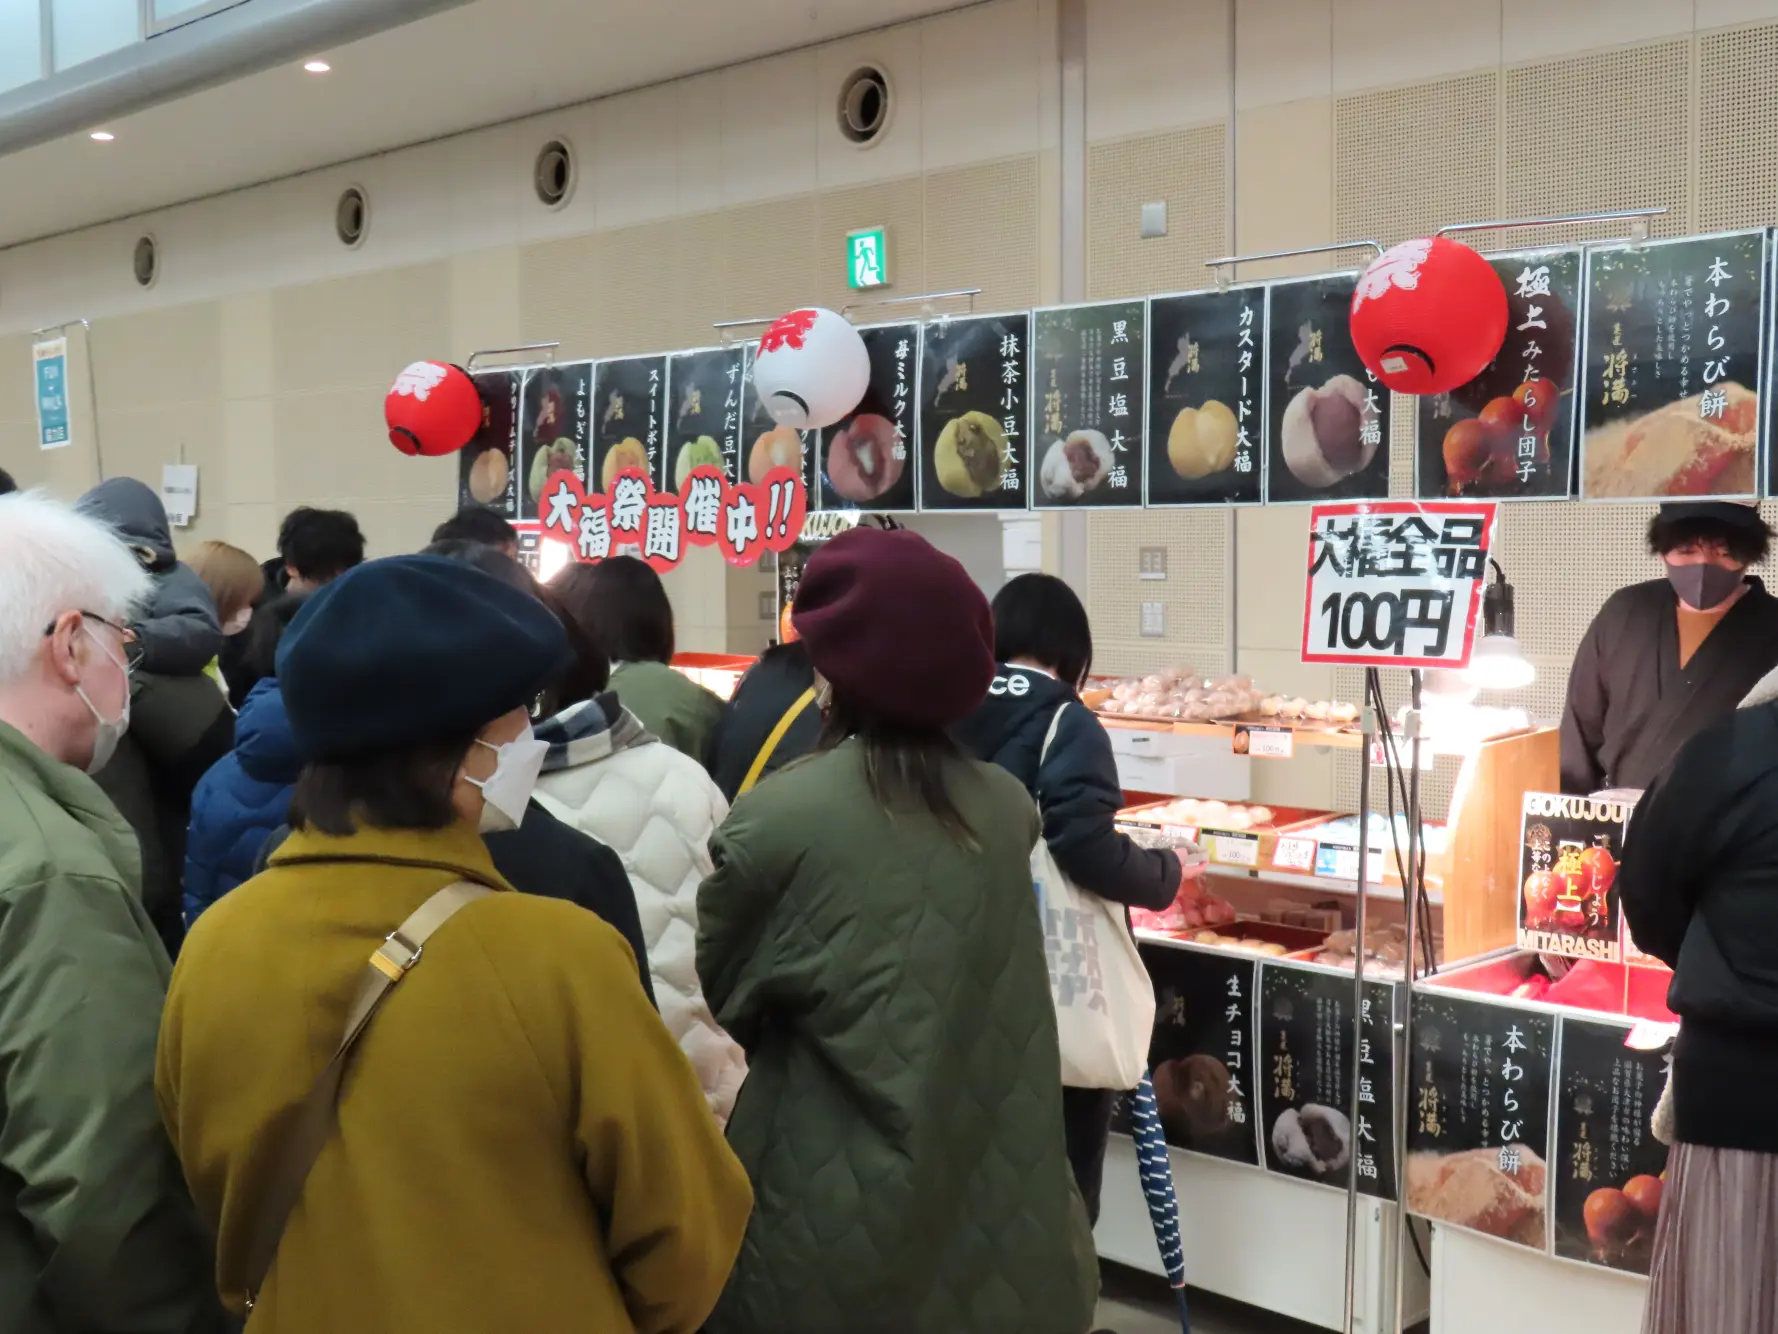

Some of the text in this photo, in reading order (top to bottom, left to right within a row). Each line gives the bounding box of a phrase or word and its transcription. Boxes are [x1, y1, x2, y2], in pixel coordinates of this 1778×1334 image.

[892, 339, 910, 461] 苺ミルク大福
[999, 334, 1021, 491] 抹茶小豆大福
[1108, 320, 1129, 489] 黒豆塩大福
[1234, 306, 1255, 473] カスタード大福
[1513, 266, 1551, 484] 極上みたらし団子
[1699, 256, 1733, 420] 本わらび餅
[1321, 589, 1455, 657] 100円
[1520, 931, 1620, 960] MITARASHI
[1225, 974, 1246, 1125] 生チョコ大福
[1499, 1024, 1527, 1176] 本わらび餅
